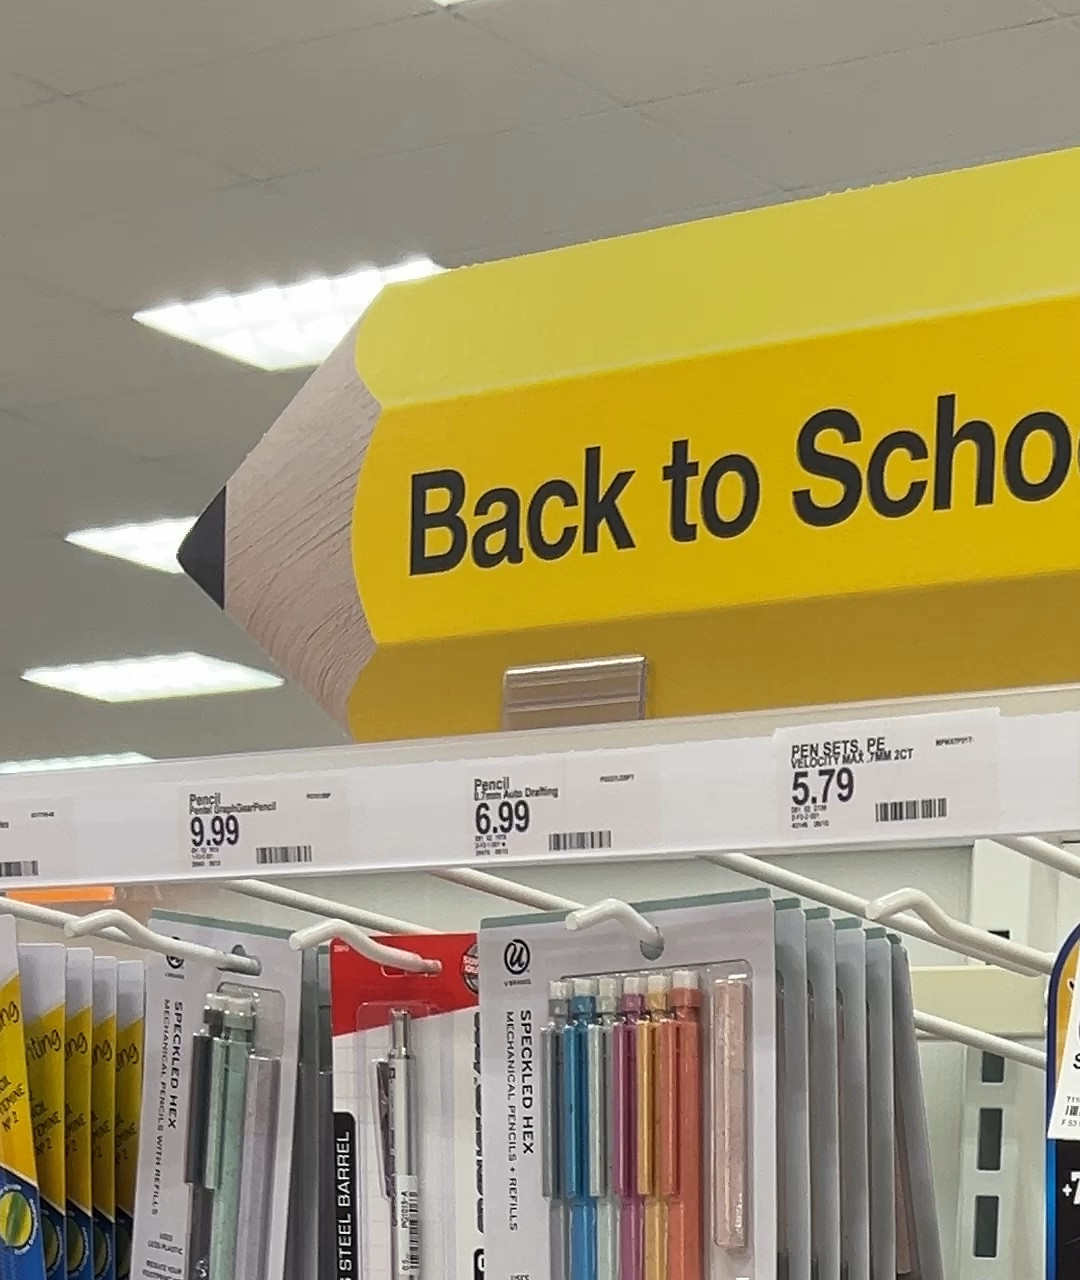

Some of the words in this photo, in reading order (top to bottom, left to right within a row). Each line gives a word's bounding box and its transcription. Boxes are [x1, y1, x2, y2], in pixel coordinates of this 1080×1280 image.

[409, 447, 636, 576] Back
[664, 438, 760, 543] to
[792, 744, 818, 758] PEN
[867, 737, 885, 750] PE
[189, 793, 220, 806] Pencil
[474, 776, 509, 791] Pencil
[792, 767, 854, 805] 5.79
[190, 815, 239, 846] 9.99
[476, 800, 529, 834] 6.99
[506, 1011, 516, 1100] MECHANICAL
[520, 1010, 534, 1109] SPECKLED
[508, 1106, 517, 1161] PENCILS
[522, 1116, 534, 1154] HEX
[336, 1131, 351, 1207] BARREL
[510, 1178, 518, 1231] REFILLS
[338, 1212, 352, 1271] STEEL
